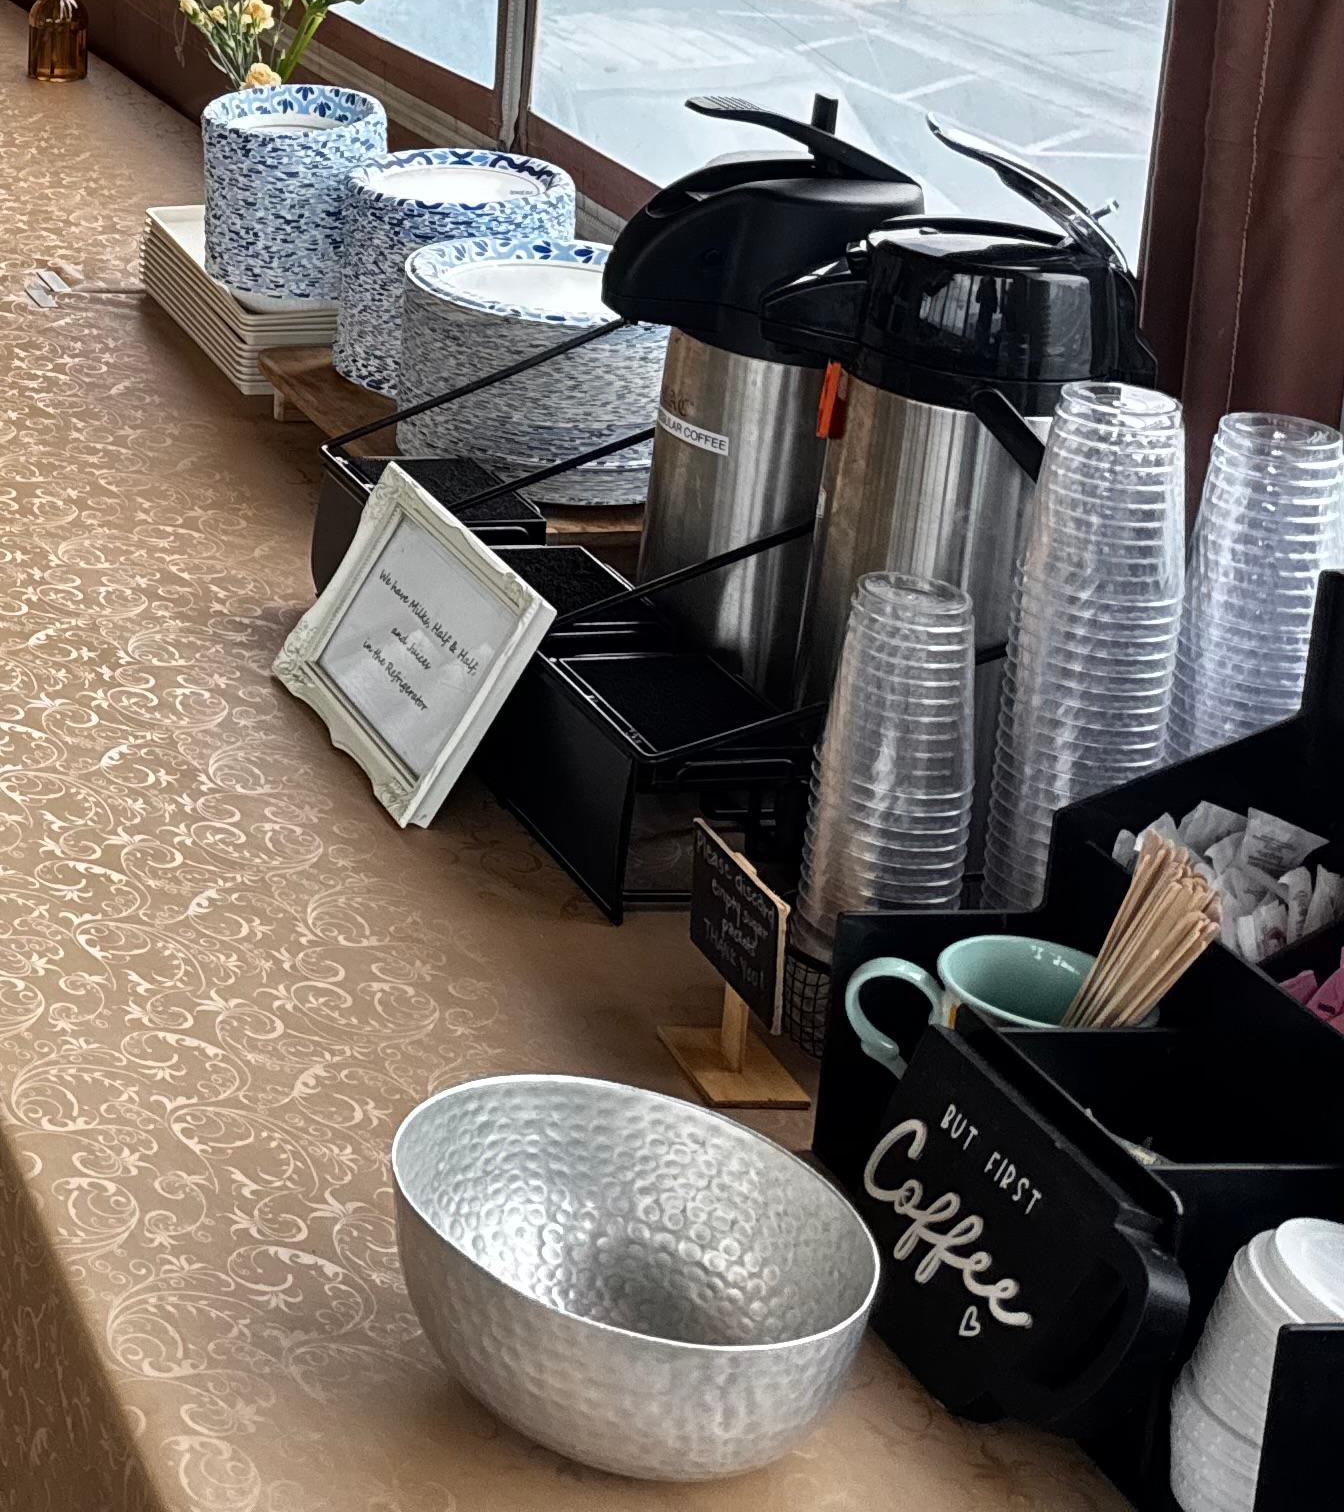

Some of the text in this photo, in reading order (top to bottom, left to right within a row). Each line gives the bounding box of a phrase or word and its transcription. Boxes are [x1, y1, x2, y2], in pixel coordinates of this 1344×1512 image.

[683, 427, 728, 451] COFFEE
[379, 569, 391, 586] We
[390, 580, 410, 604] have
[431, 622, 453, 648] Half
[448, 640, 459, 654] &
[363, 639, 428, 711] in the Refrigerator
[391, 627, 432, 670] and Juices
[712, 877, 741, 928] empty
[940, 1103, 1042, 1215] BUT FIRST
[863, 1118, 1033, 1329] Coffee
